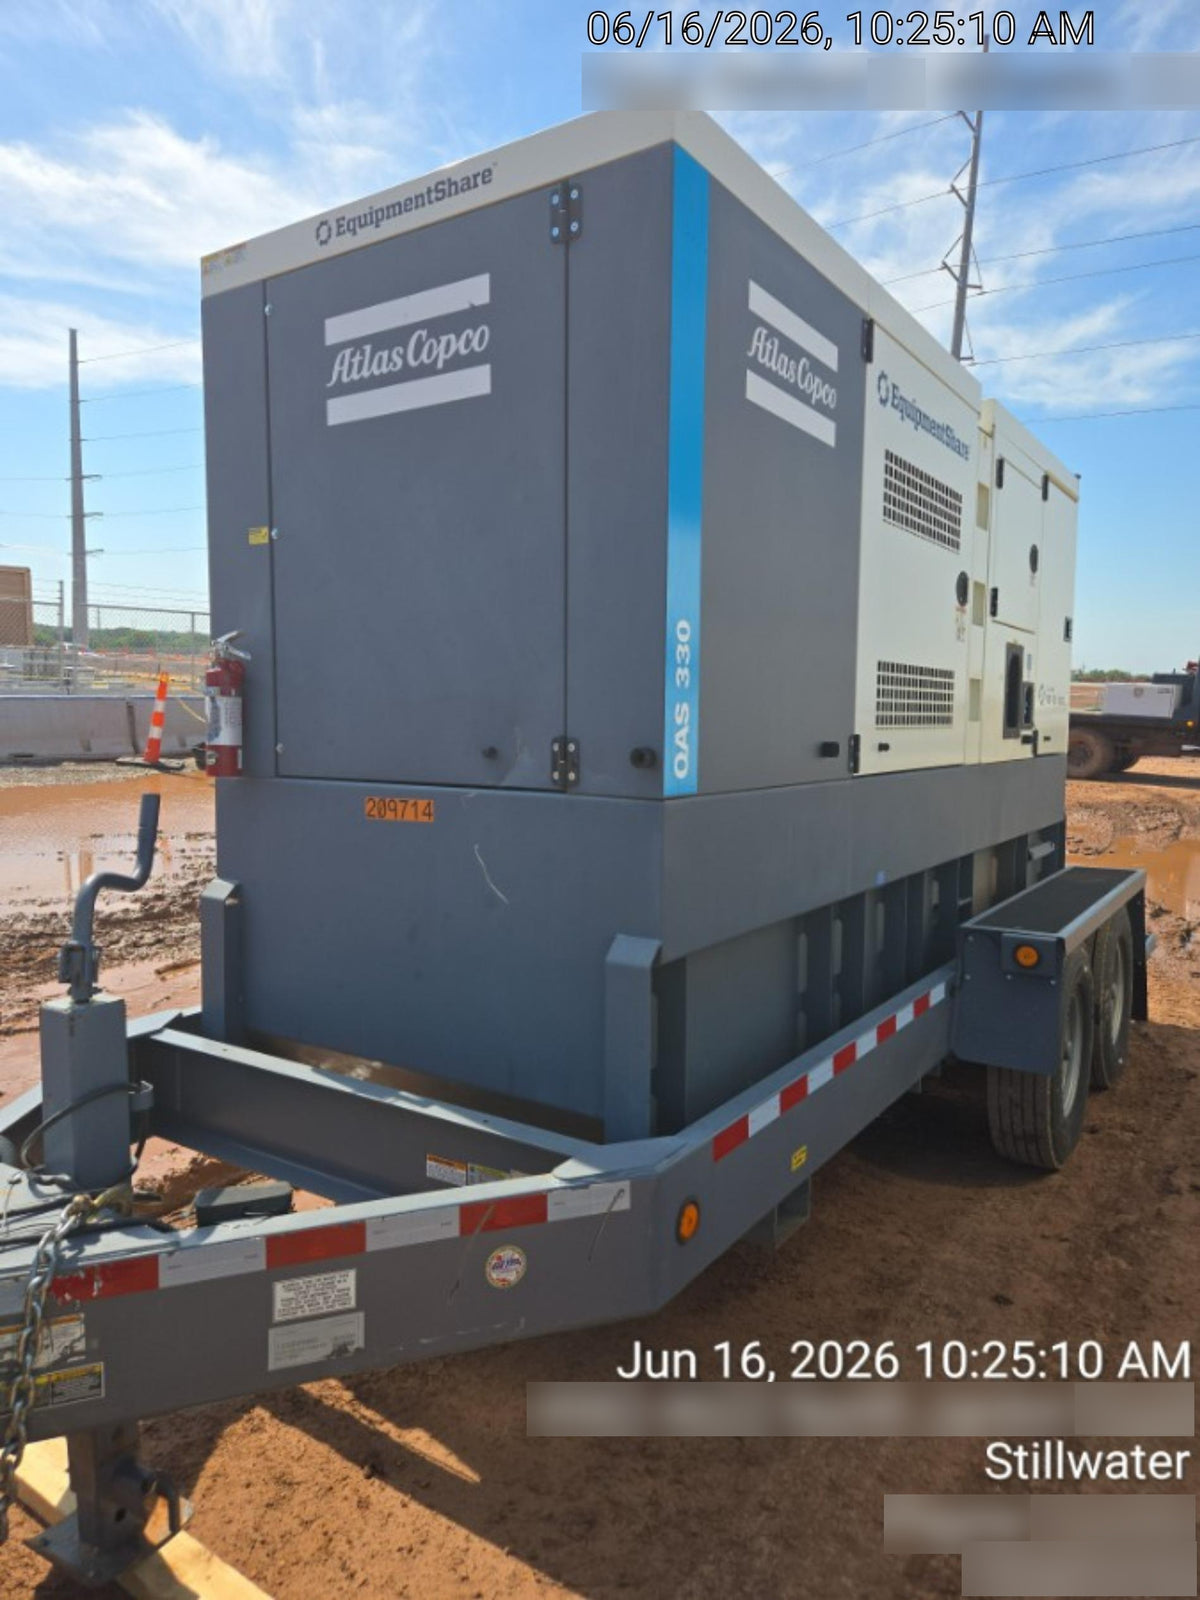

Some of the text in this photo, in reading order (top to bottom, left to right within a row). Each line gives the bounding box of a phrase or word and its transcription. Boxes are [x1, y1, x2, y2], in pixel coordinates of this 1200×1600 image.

[335, 166, 493, 237] EquipmentShare
[326, 324, 490, 387] Atlas Copco
[747, 326, 837, 409] Atlas Copco
[891, 382, 970, 461] EquipmentShare
[675, 619, 691, 689] 330
[366, 797, 434, 821] 209714
